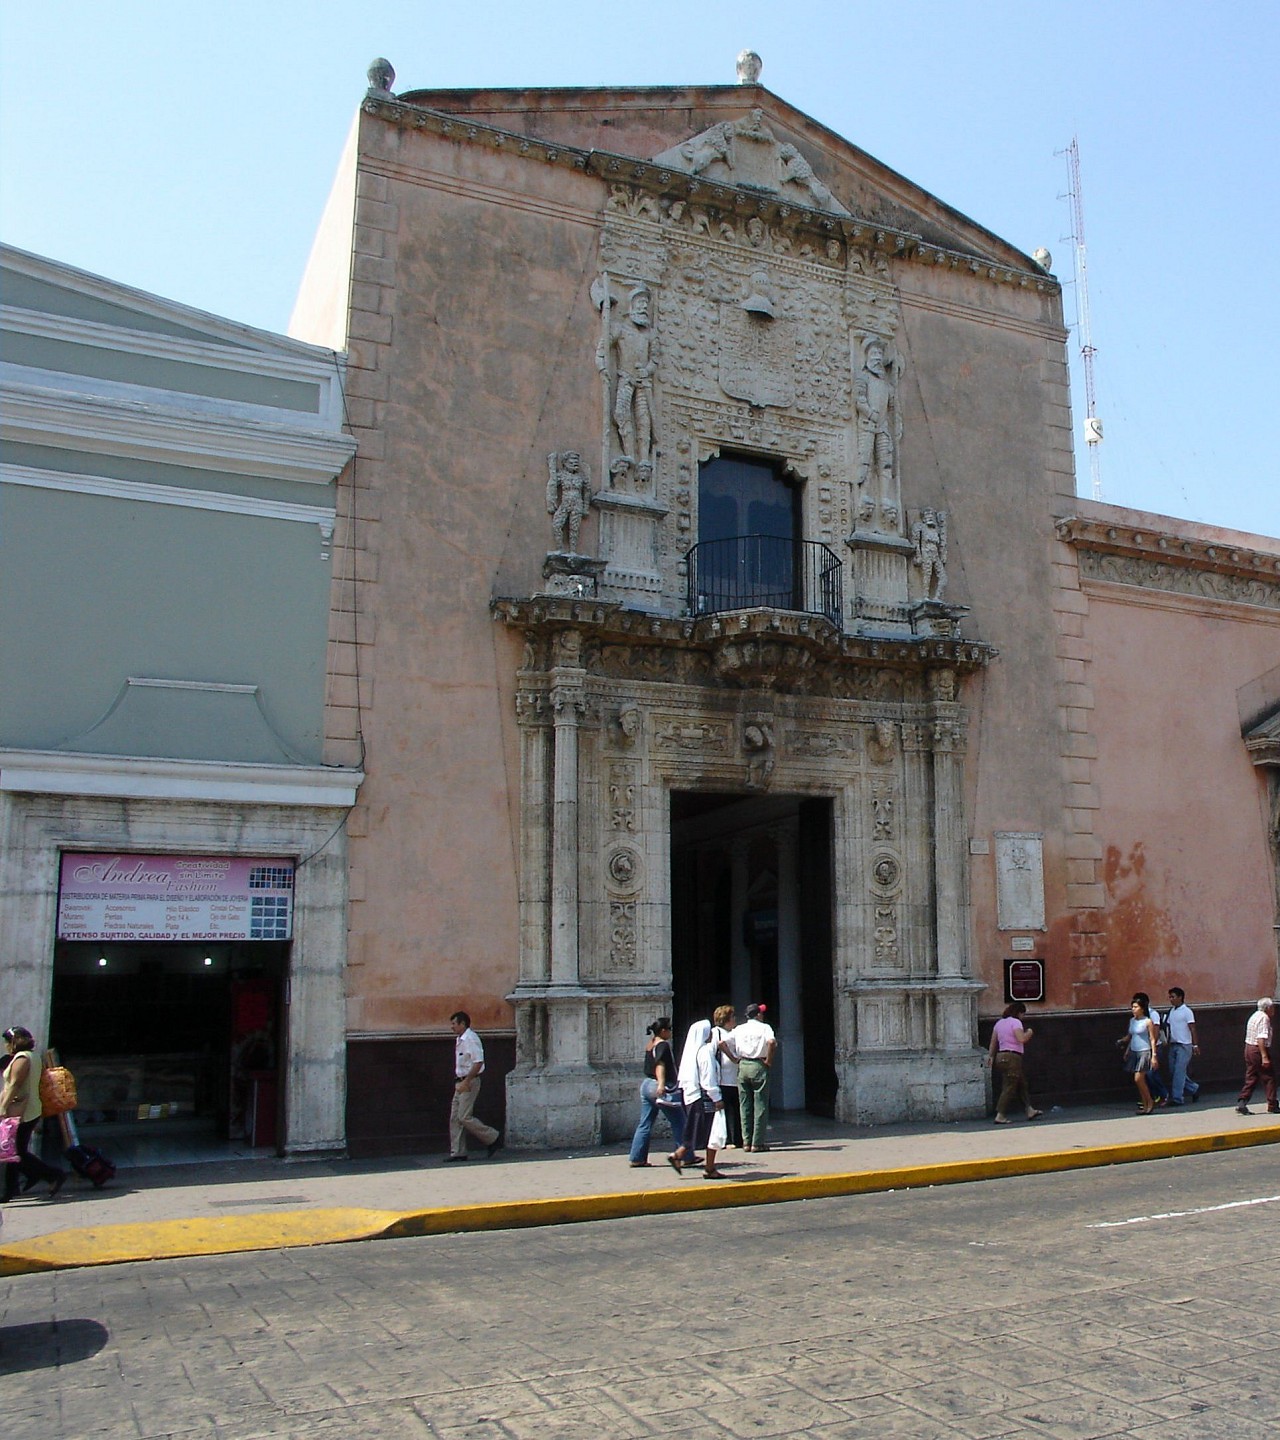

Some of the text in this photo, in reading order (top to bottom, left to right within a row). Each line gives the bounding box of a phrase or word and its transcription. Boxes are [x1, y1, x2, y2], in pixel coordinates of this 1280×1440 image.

[74, 857, 169, 883] Andrea
[175, 861, 230, 870] Creatividad
[166, 880, 217, 891] Fashion
